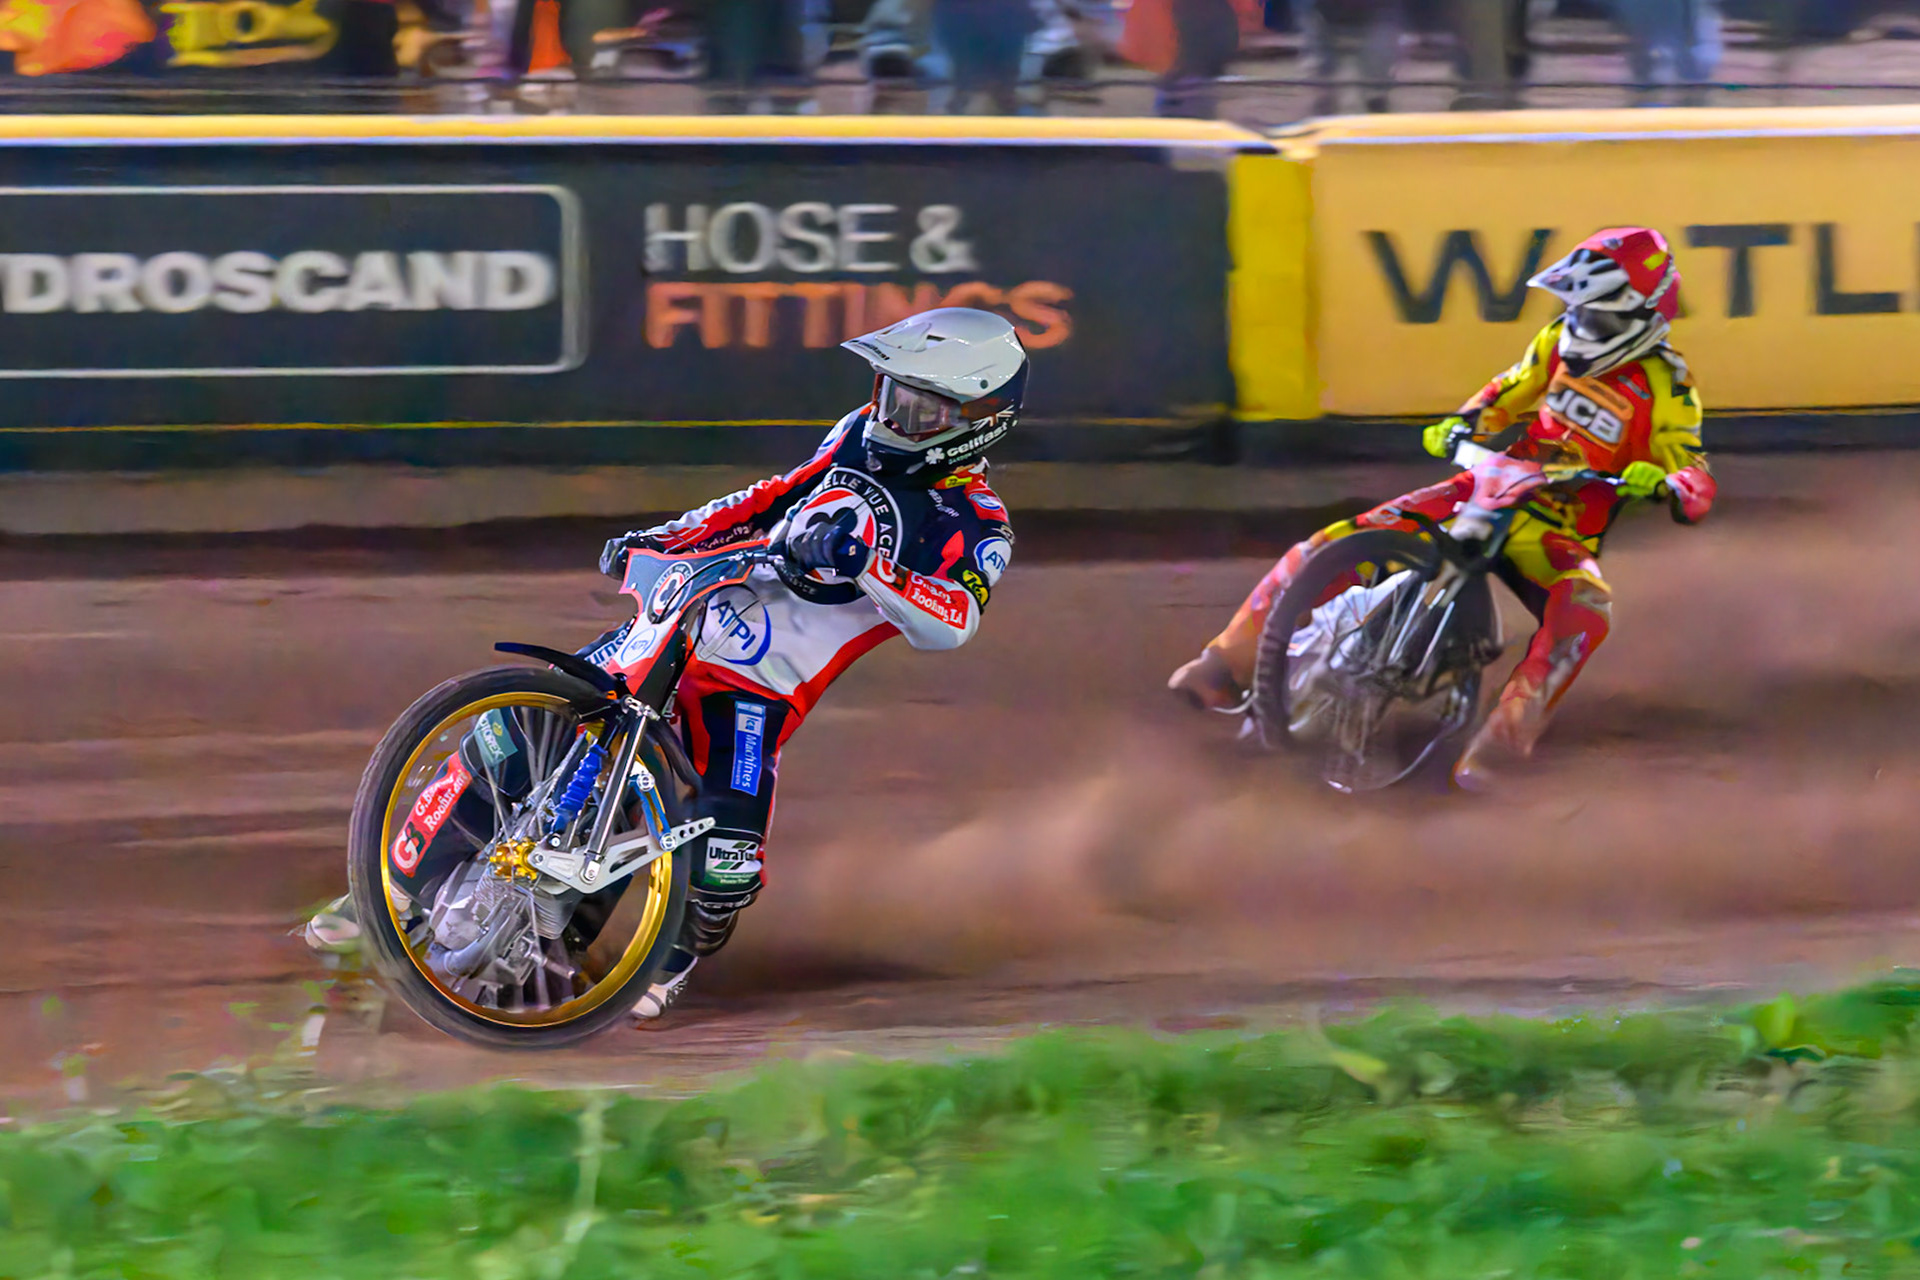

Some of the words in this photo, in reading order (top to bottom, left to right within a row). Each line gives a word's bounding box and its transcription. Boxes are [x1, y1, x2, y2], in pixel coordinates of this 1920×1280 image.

[644, 202, 899, 274] HOSE
[910, 205, 978, 274] &
[0, 251, 556, 314] DROSCAND
[1362, 222, 1920, 325] WTL
[946, 421, 1008, 457] cellfast
[1545, 388, 1625, 444] JCB
[816, 473, 861, 493] ELLE
[862, 486, 890, 515] VUE
[877, 522, 893, 558] ACE
[711, 600, 757, 652] ATPI
[479, 717, 507, 760] OTOREX
[741, 734, 757, 788] Machines
